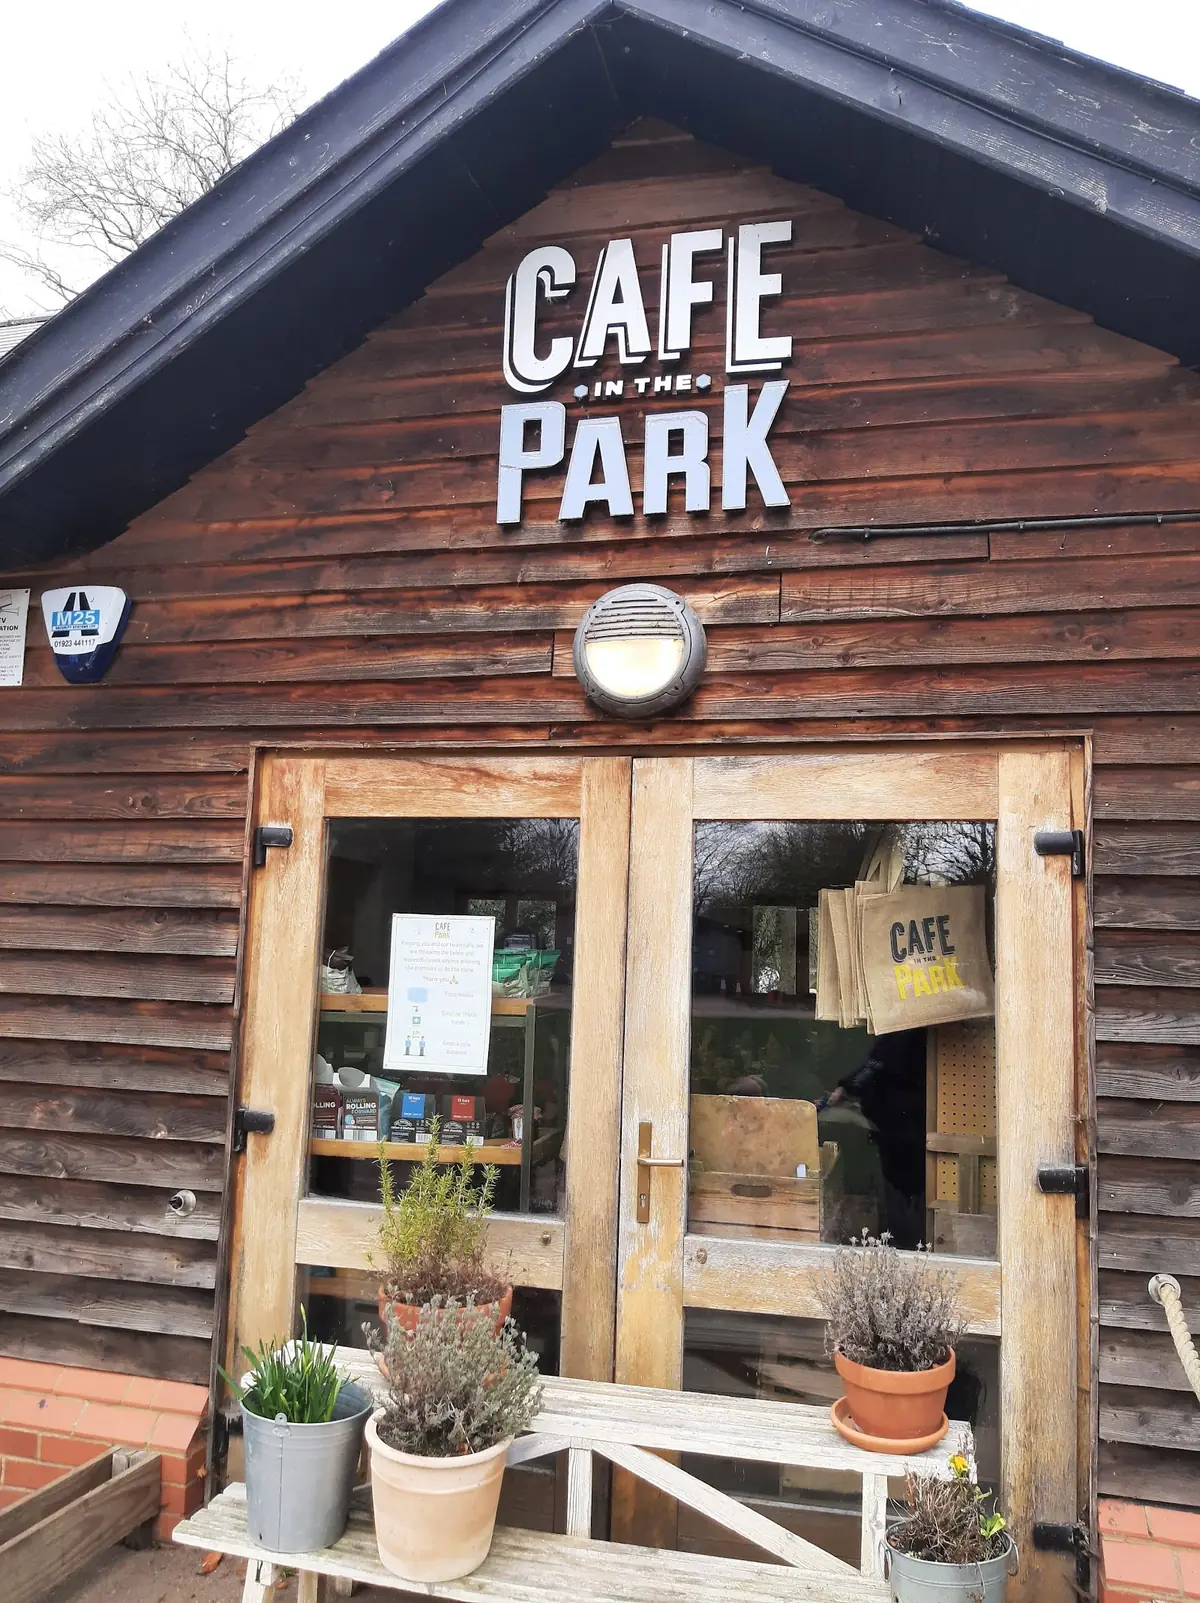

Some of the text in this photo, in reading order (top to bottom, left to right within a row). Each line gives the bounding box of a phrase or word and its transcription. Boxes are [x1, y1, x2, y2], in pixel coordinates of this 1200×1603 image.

[502, 220, 792, 393] CAFE
[594, 374, 693, 397] IN THE
[496, 379, 792, 524] PARK
[57, 611, 96, 625] M25
[54, 640, 73, 648] 01923
[434, 931, 451, 939] PARK
[435, 922, 451, 931] CAFE
[889, 914, 955, 963] CAFE
[893, 956, 965, 1000] PARK
[312, 1101, 336, 1109] LLING
